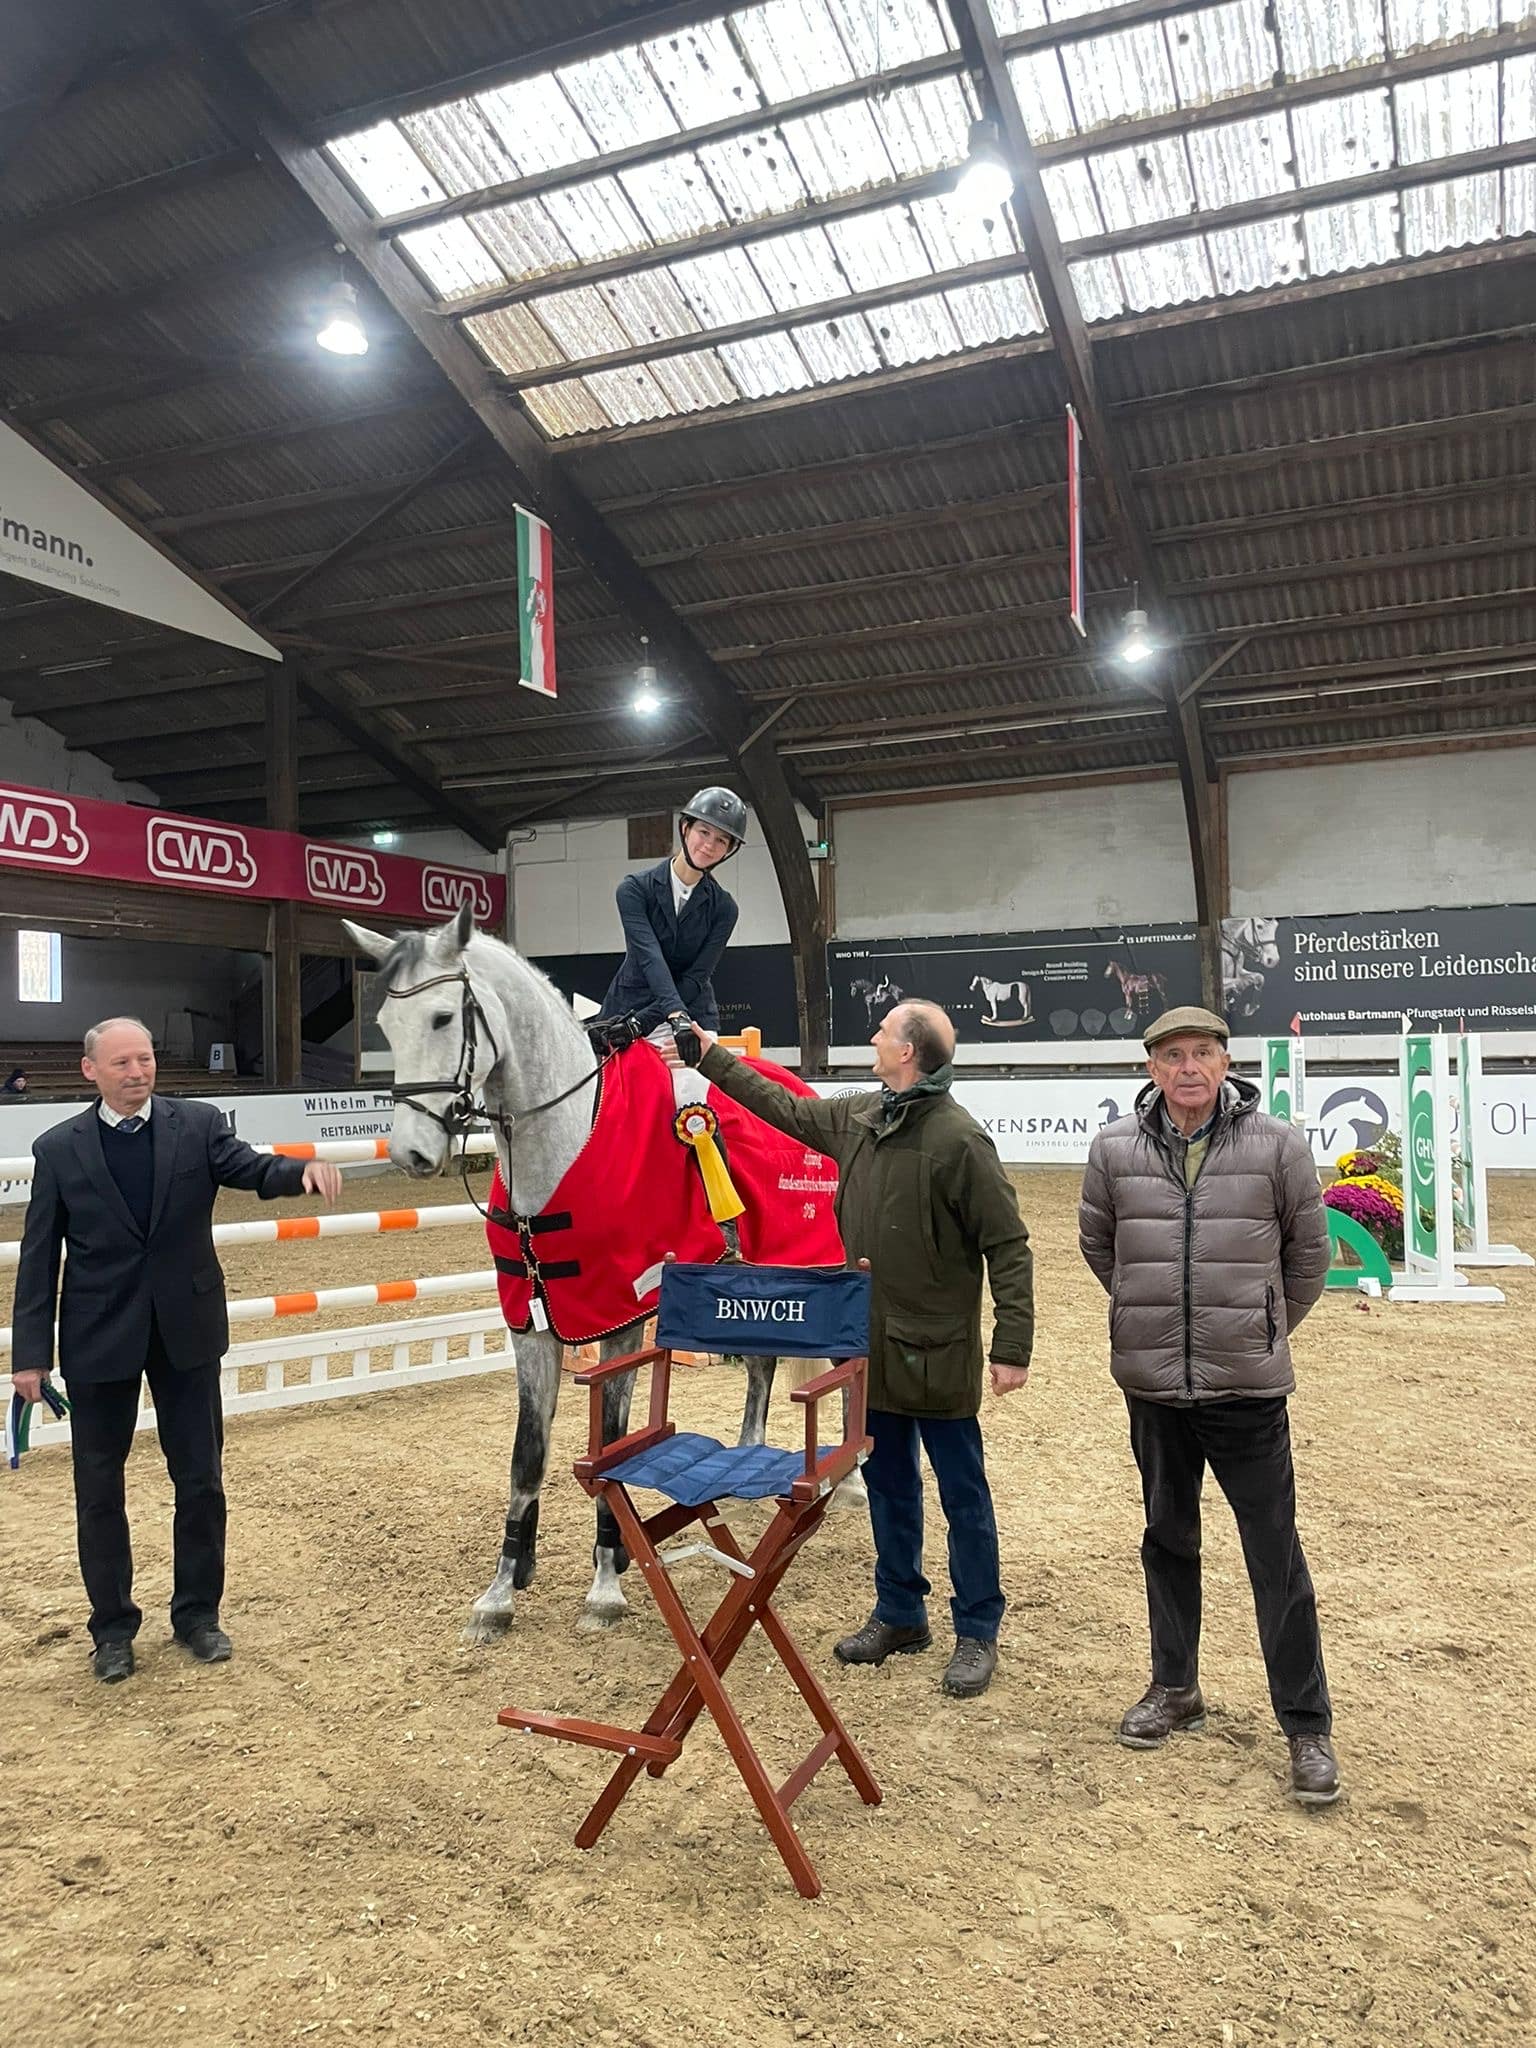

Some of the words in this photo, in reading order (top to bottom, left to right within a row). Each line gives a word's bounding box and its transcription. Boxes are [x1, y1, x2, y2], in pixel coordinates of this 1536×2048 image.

[0, 517, 94, 568] mann.
[157, 830, 233, 874] CWD
[310, 856, 366, 893] CWD
[428, 876, 477, 908] CWD
[1294, 928, 1440, 954] Pferdestärken
[1294, 960, 1338, 982] sind
[1343, 962, 1415, 980] unsere
[1406, 1007, 1465, 1020] Pfungstadt
[1467, 1006, 1489, 1016] und
[213, 1050, 221, 1061] B
[304, 1098, 366, 1111] Wilhelm
[321, 1123, 394, 1137] REITBAHNPLA
[715, 1298, 807, 1322] BNWCH
